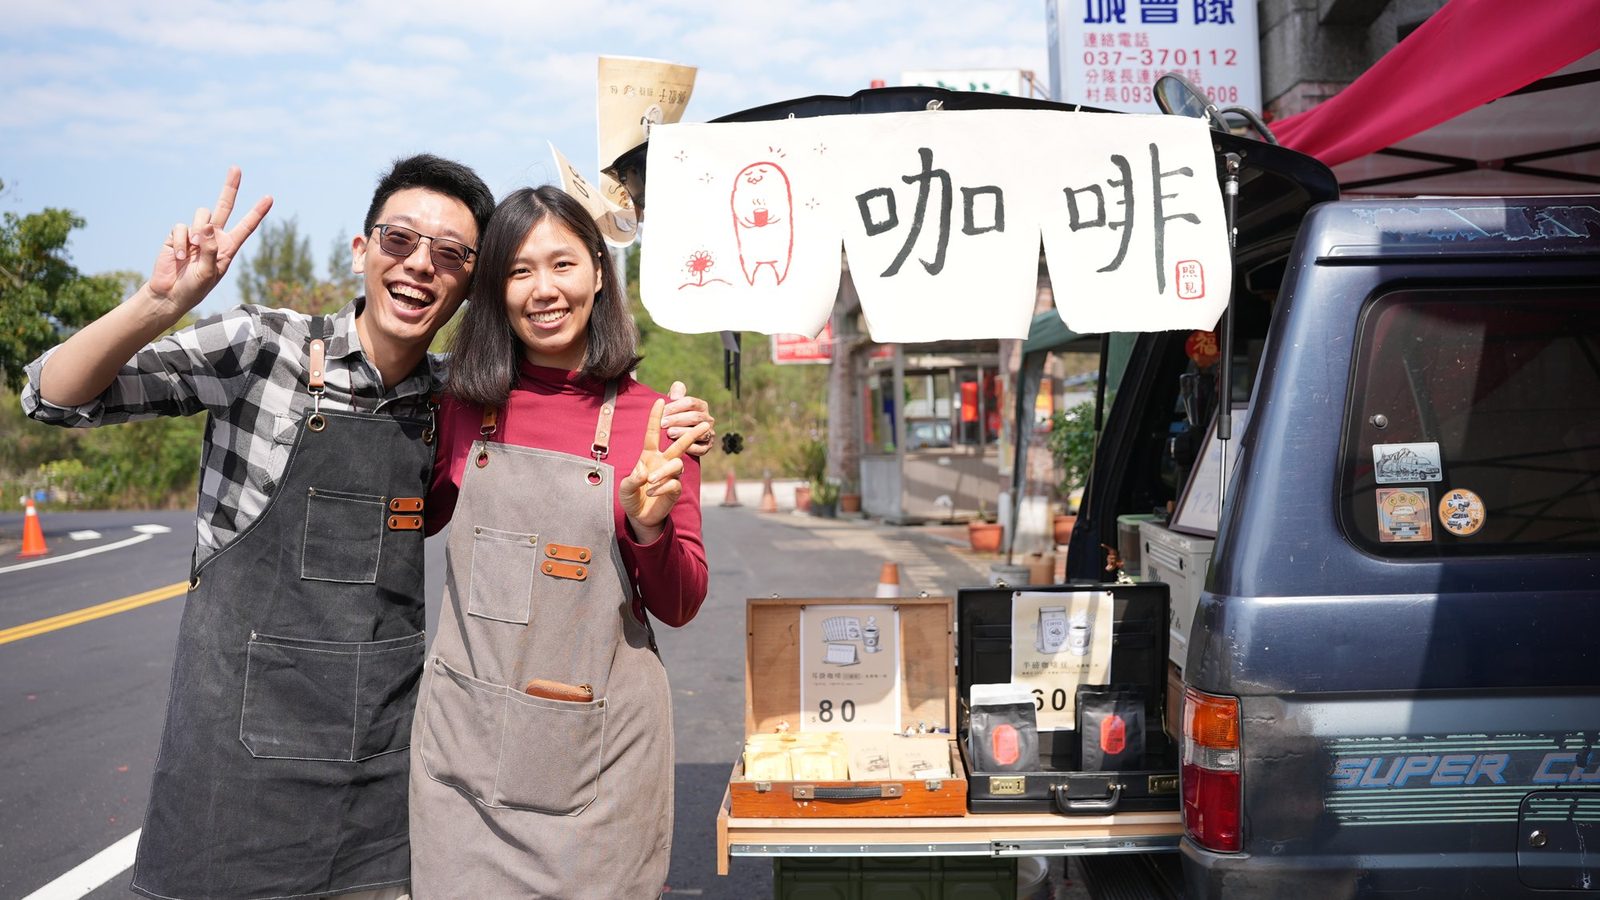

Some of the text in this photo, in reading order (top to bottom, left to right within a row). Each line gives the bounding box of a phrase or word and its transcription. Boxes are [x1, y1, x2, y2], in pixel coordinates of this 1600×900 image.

[1083, 32, 1149, 47] 連絡電話
[1083, 49, 1237, 66] 037-370112
[1086, 69, 1202, 84] 分隊長連絡話
[855, 143, 1201, 294] 咖啡
[1182, 264, 1198, 294] 照見
[1331, 753, 1511, 789] SUPER
